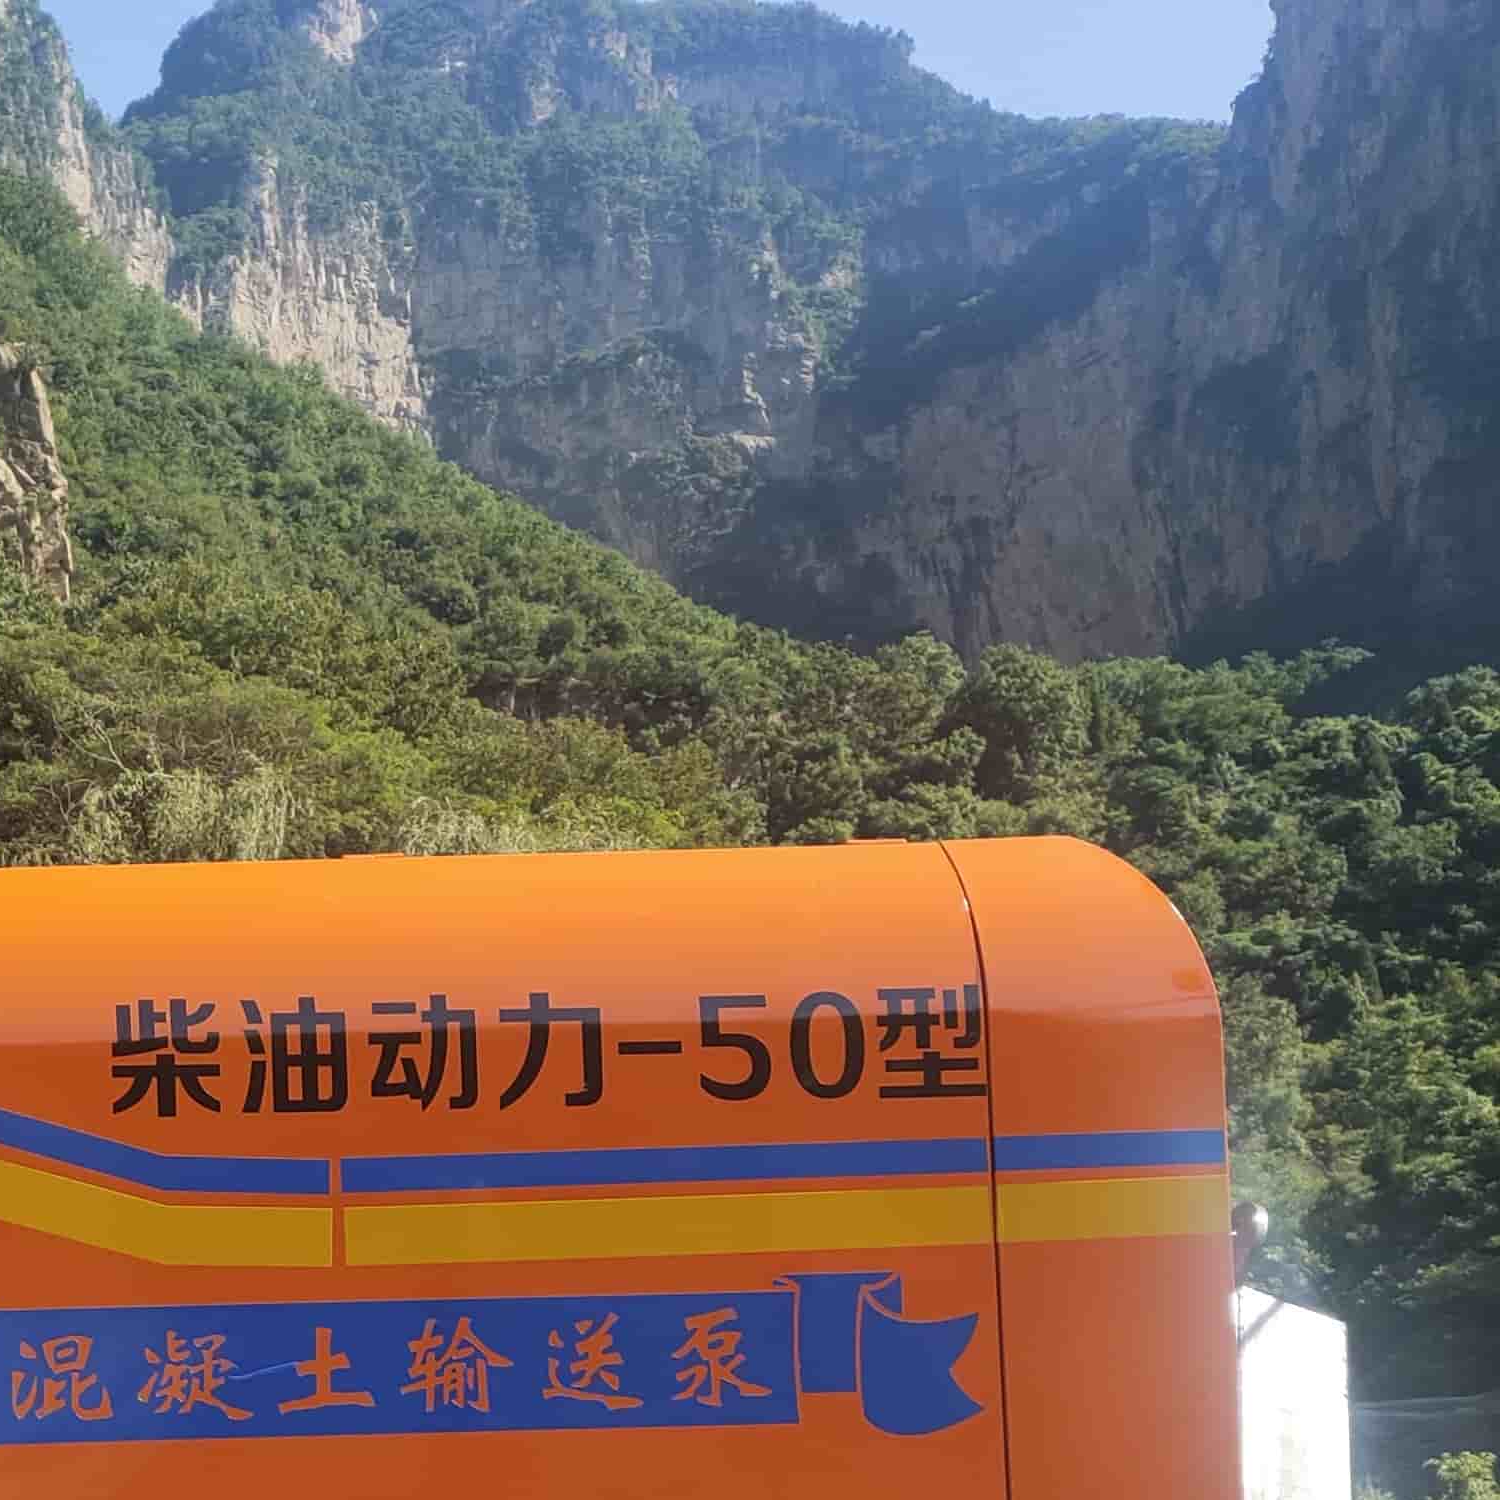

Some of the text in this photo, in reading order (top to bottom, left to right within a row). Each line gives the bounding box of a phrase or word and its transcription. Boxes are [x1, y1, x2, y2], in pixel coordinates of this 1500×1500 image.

[111, 984, 988, 1118] 柴油动力-50型
[11, 1308, 773, 1420] 混凝土输送泵
